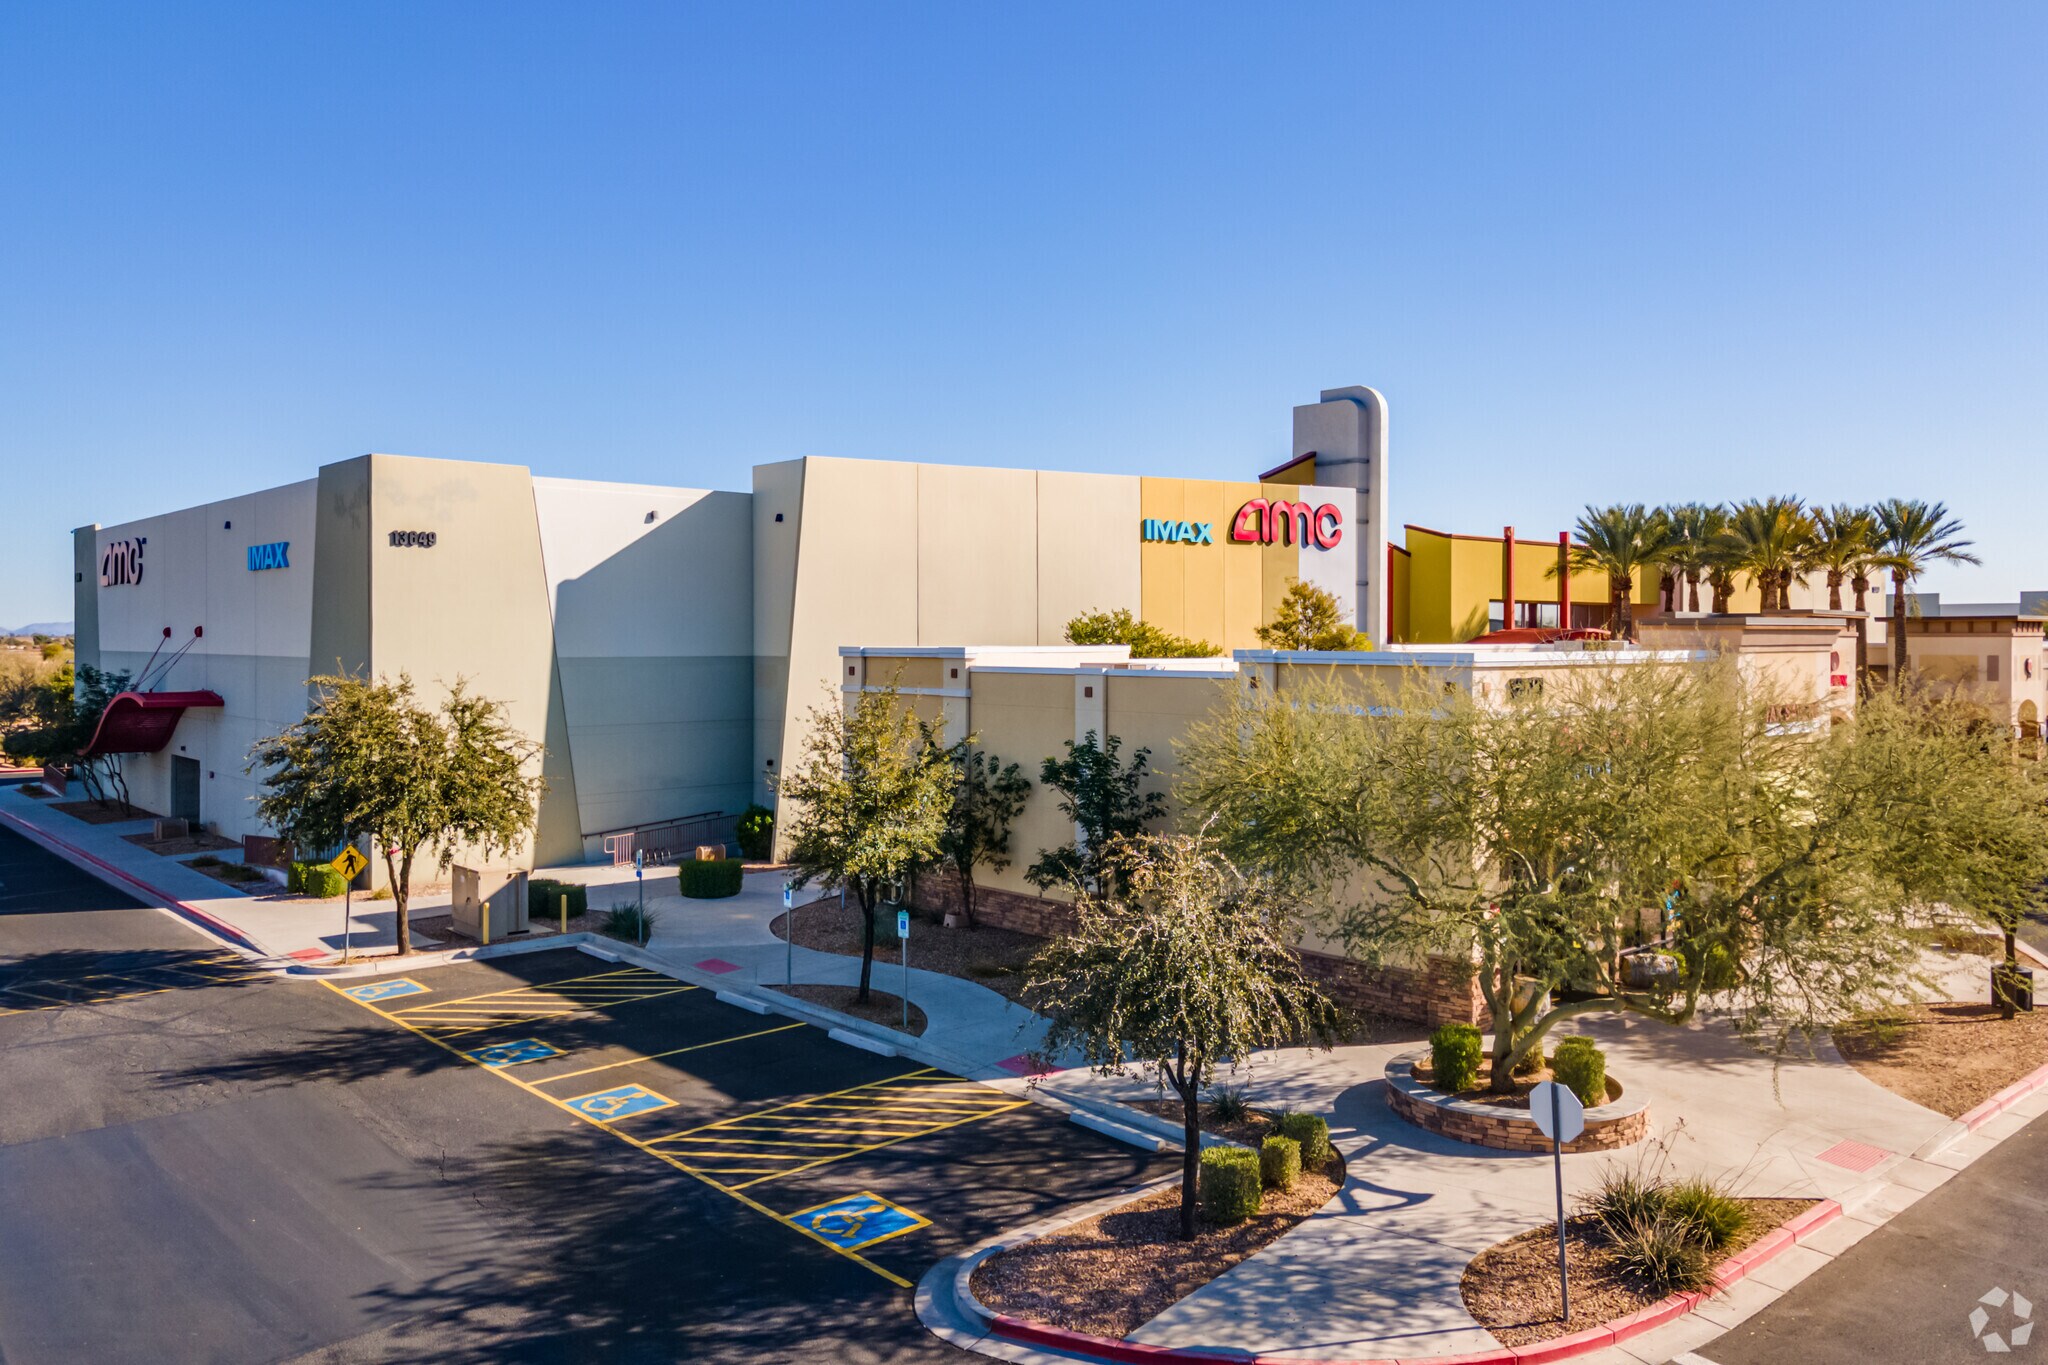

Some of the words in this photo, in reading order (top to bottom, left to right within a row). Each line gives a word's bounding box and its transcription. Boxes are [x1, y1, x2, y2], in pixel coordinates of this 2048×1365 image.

[388, 530, 436, 548] 13649
[1144, 518, 1213, 544] IMAX
[247, 542, 289, 571] IMAX
